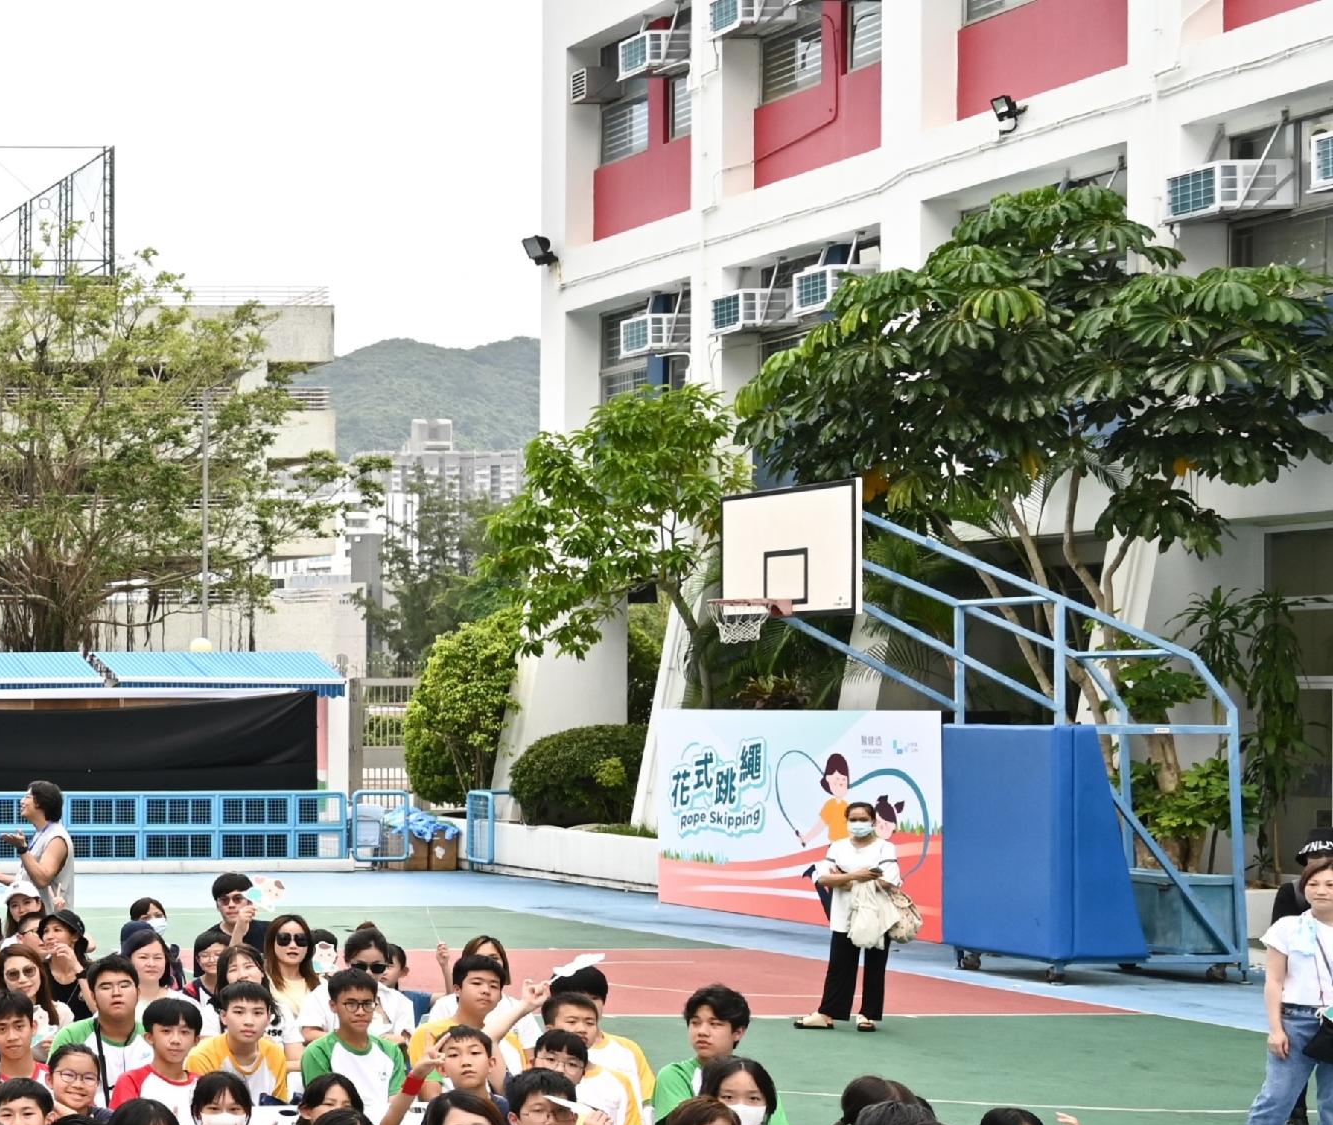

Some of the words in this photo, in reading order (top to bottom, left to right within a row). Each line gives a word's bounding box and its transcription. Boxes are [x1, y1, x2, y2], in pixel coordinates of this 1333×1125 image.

[672, 743, 762, 807] 花式跳繩
[680, 812, 707, 830] Rope
[710, 809, 761, 829] Skipping
